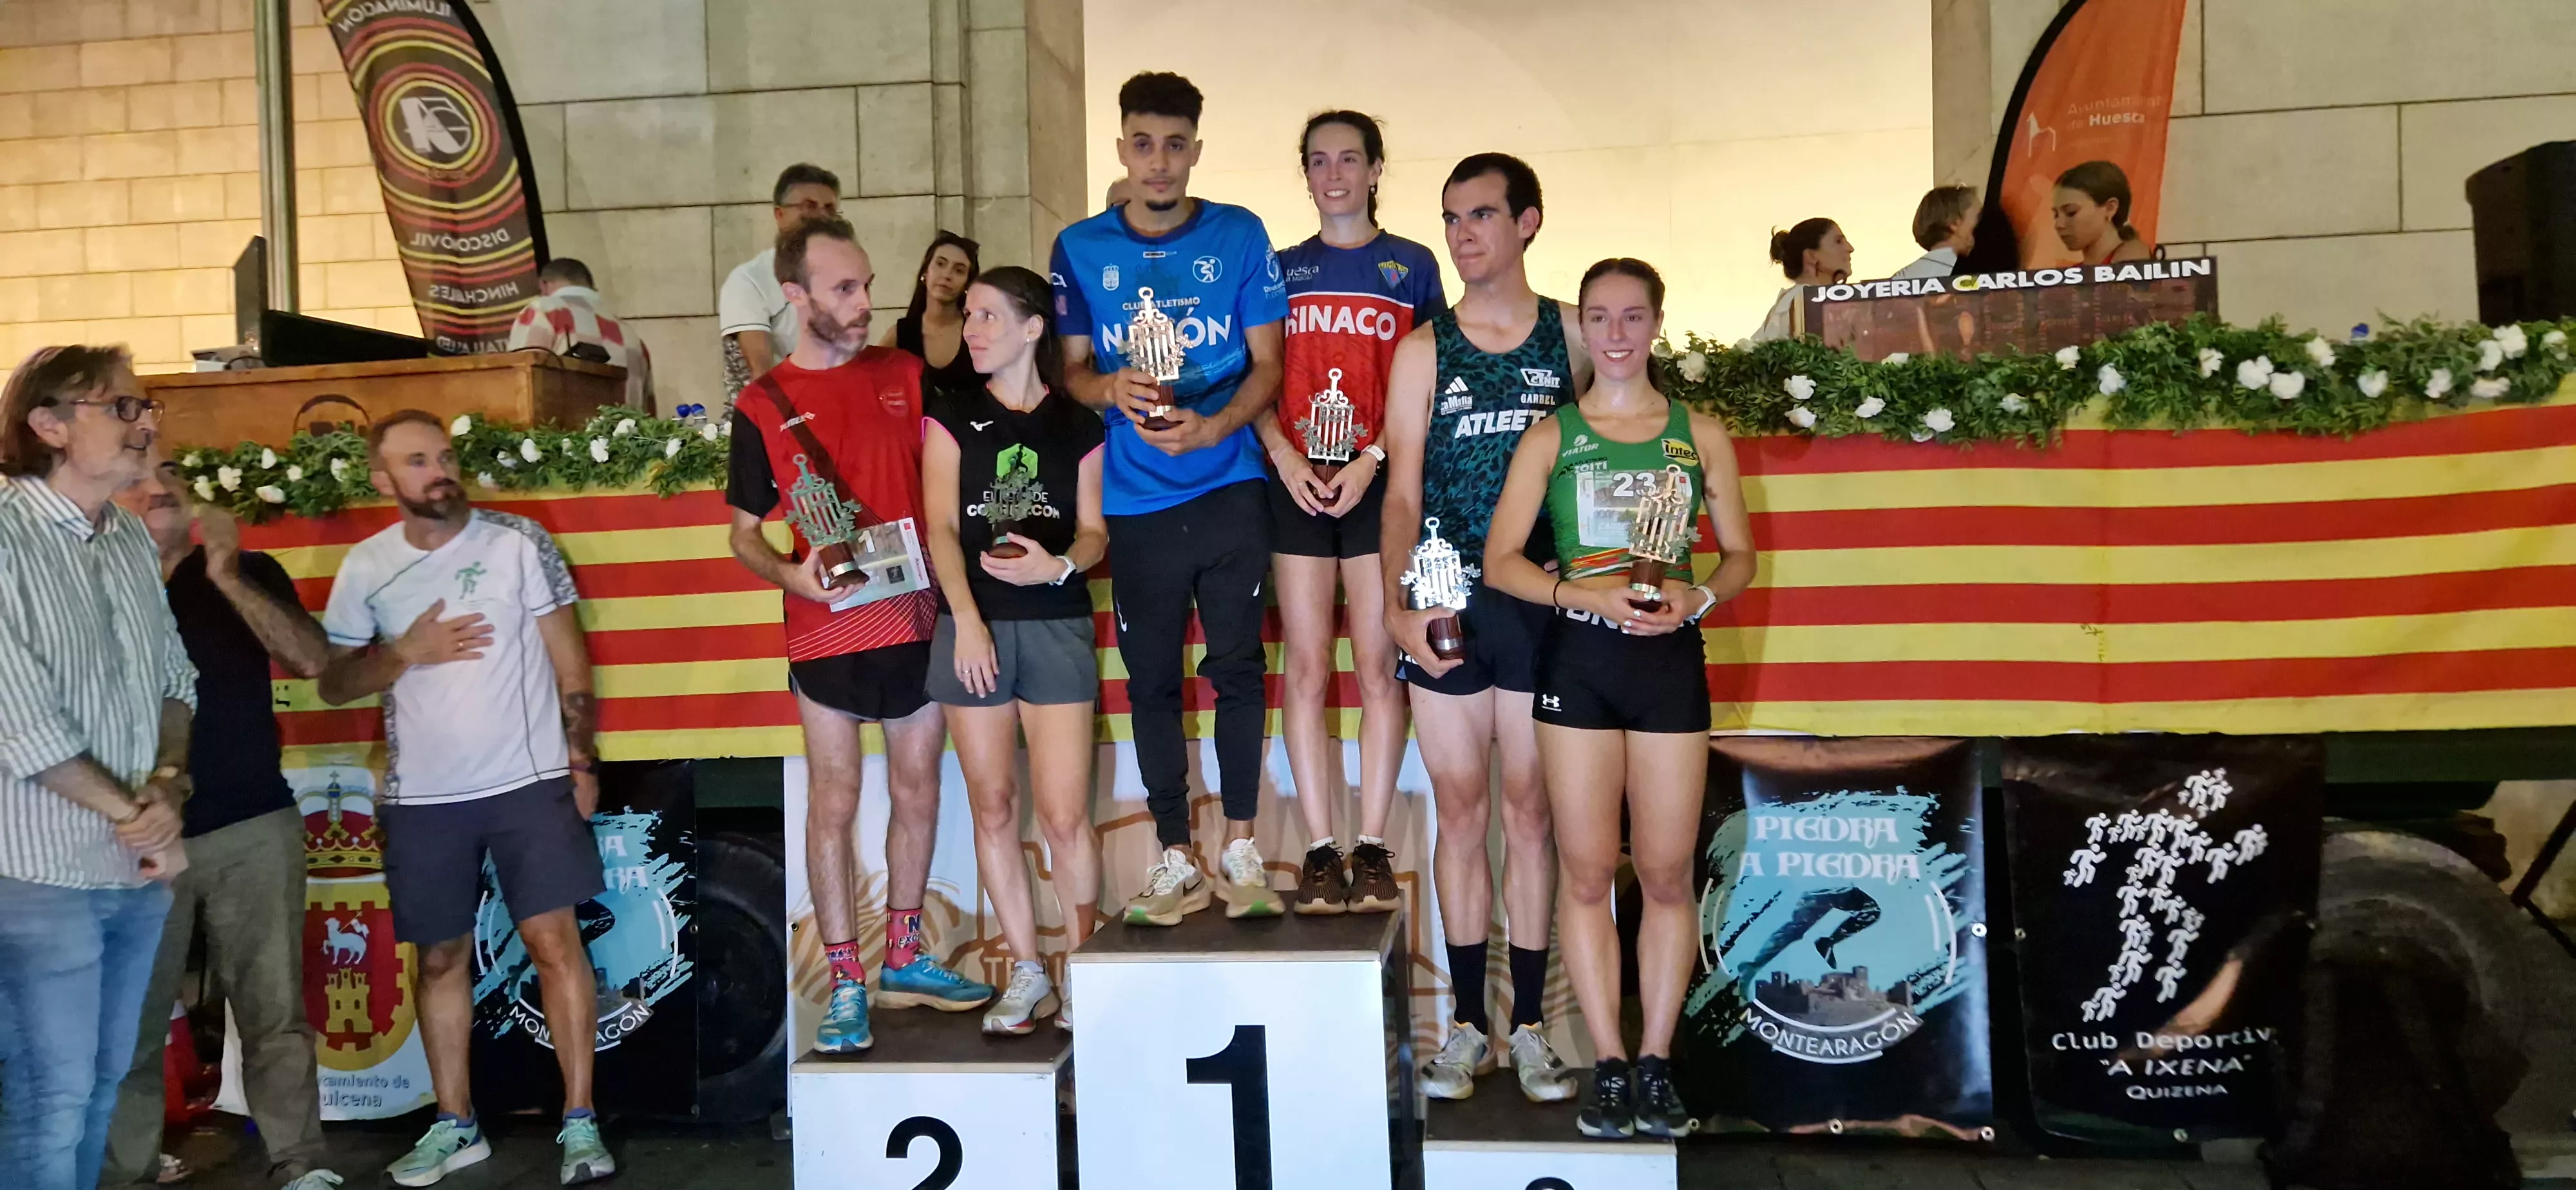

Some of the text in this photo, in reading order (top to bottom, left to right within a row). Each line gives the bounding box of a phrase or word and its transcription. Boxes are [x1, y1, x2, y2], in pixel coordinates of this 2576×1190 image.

[1810, 259, 2210, 303] JOYERIA CARLOS BAILIN
[1103, 307, 1231, 352] NÓN
[1562, 444, 1599, 457] VIATOR
[1754, 815, 1899, 848] PIEDRA
[1739, 851, 1921, 884] A PIEDRA
[1739, 1008, 1918, 1057] MONTEARAGÓN
[2051, 1027, 2273, 1053] Club Deportiv
[393, 1075, 410, 1088] de
[2125, 1083, 2228, 1100] QUIZENA
[323, 1090, 383, 1108] uicena
[1186, 1025, 1273, 1190] 1
[886, 1115, 963, 1190] 2
